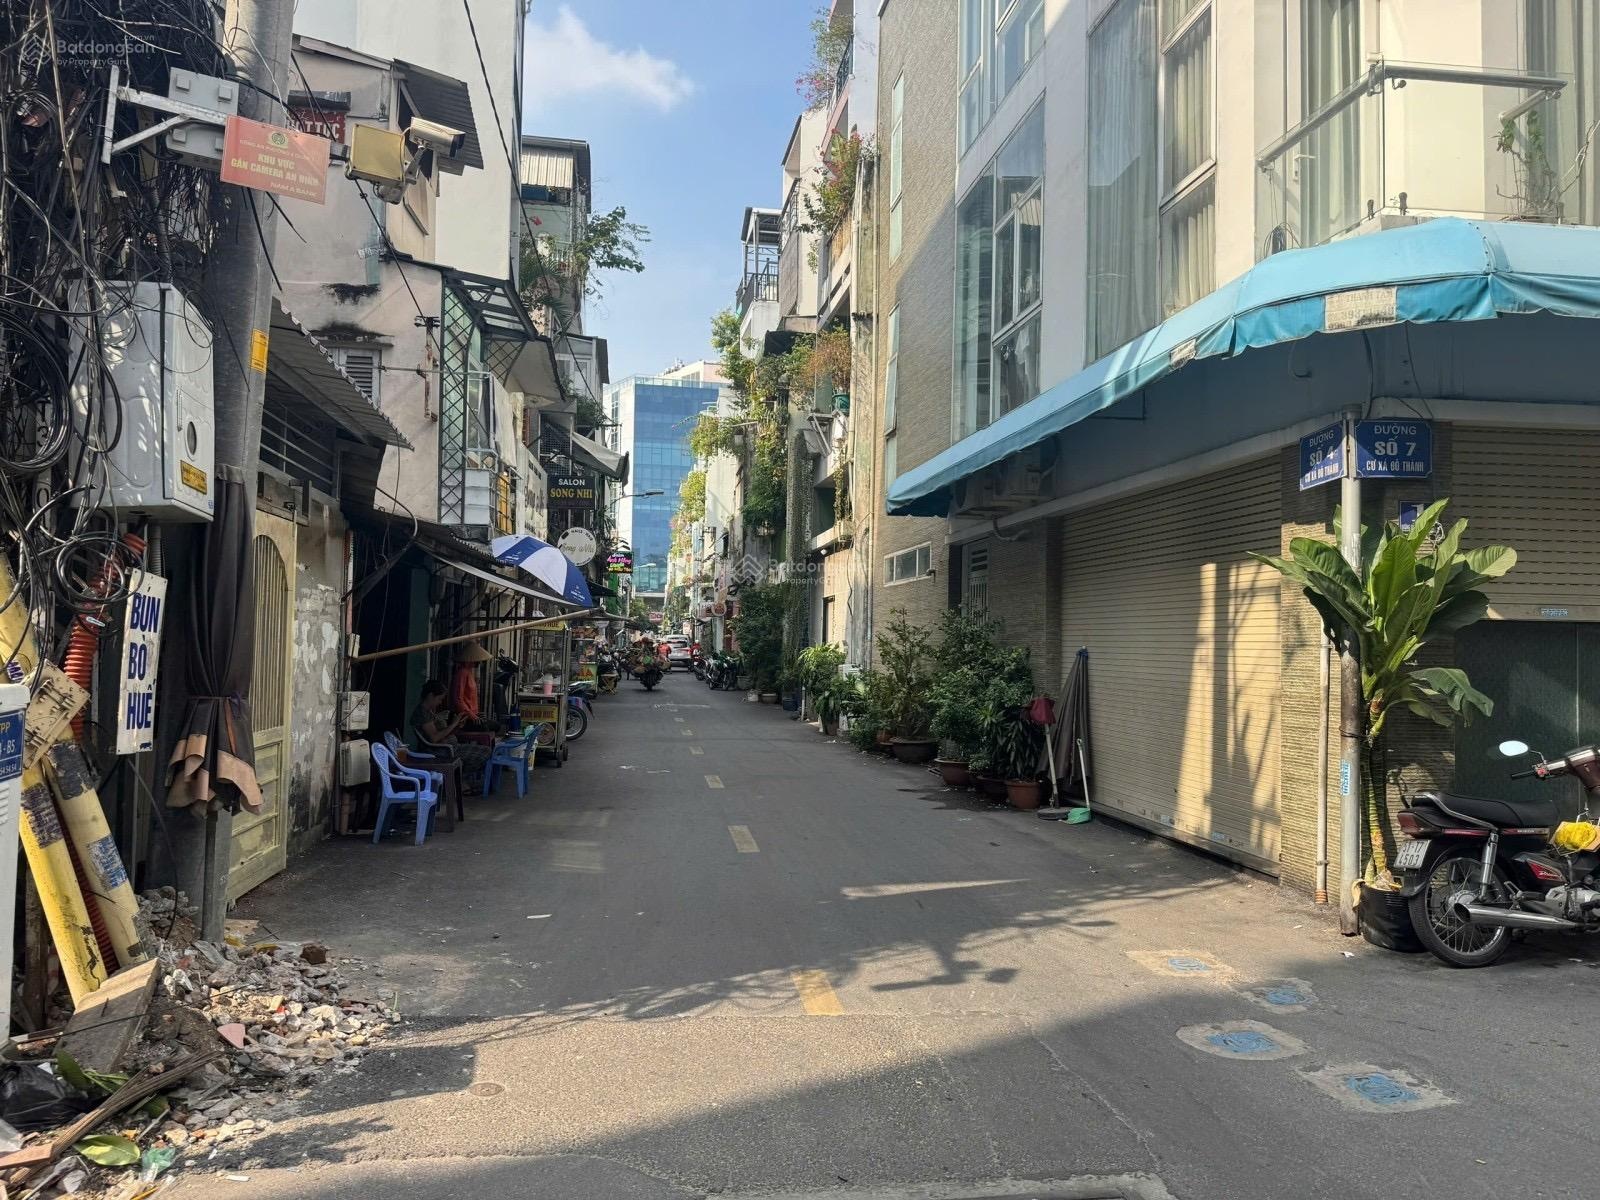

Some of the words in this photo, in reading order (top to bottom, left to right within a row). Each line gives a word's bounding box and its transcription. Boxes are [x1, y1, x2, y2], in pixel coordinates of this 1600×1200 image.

[257, 153, 276, 165] KHU
[250, 163, 284, 179] CAMERA
[1374, 424, 1418, 435] ĐƯỜNG
[1374, 435, 1398, 456] SỐ
[1406, 442, 1417, 456] 7
[1366, 458, 1377, 471] CƯ
[1378, 458, 1388, 471] XÁ
[558, 478, 586, 486] SALON
[550, 488, 574, 498] SONG
[576, 488, 593, 498] NHI
[130, 586, 161, 634] BÚN
[127, 634, 148, 681] BÒ
[126, 678, 157, 731] HUẾ
